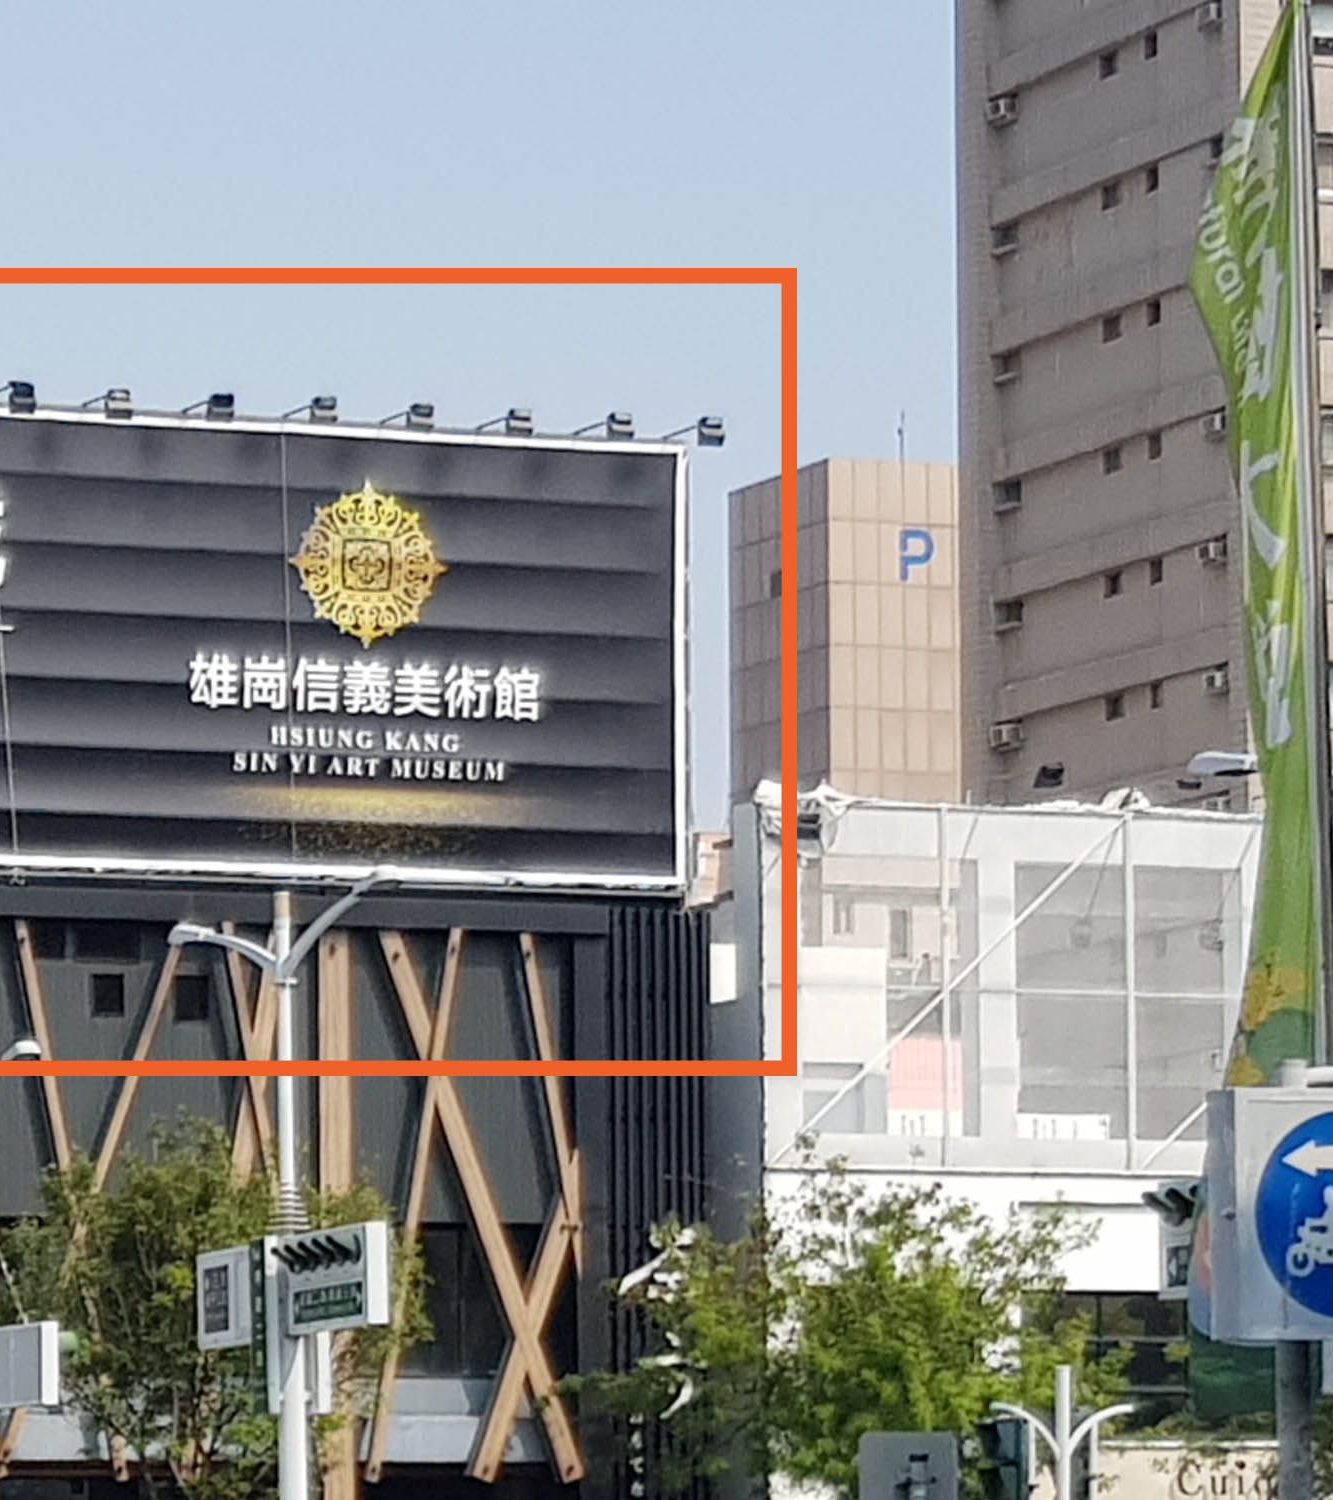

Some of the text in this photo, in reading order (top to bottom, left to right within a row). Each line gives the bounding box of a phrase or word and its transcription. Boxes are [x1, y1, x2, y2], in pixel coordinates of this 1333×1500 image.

[900, 529, 934, 581] P
[189, 652, 540, 722] 雄崗信義美術館
[271, 726, 460, 752] HSIUNG KANG
[233, 752, 505, 781] SIN YI ART MUSEUM
